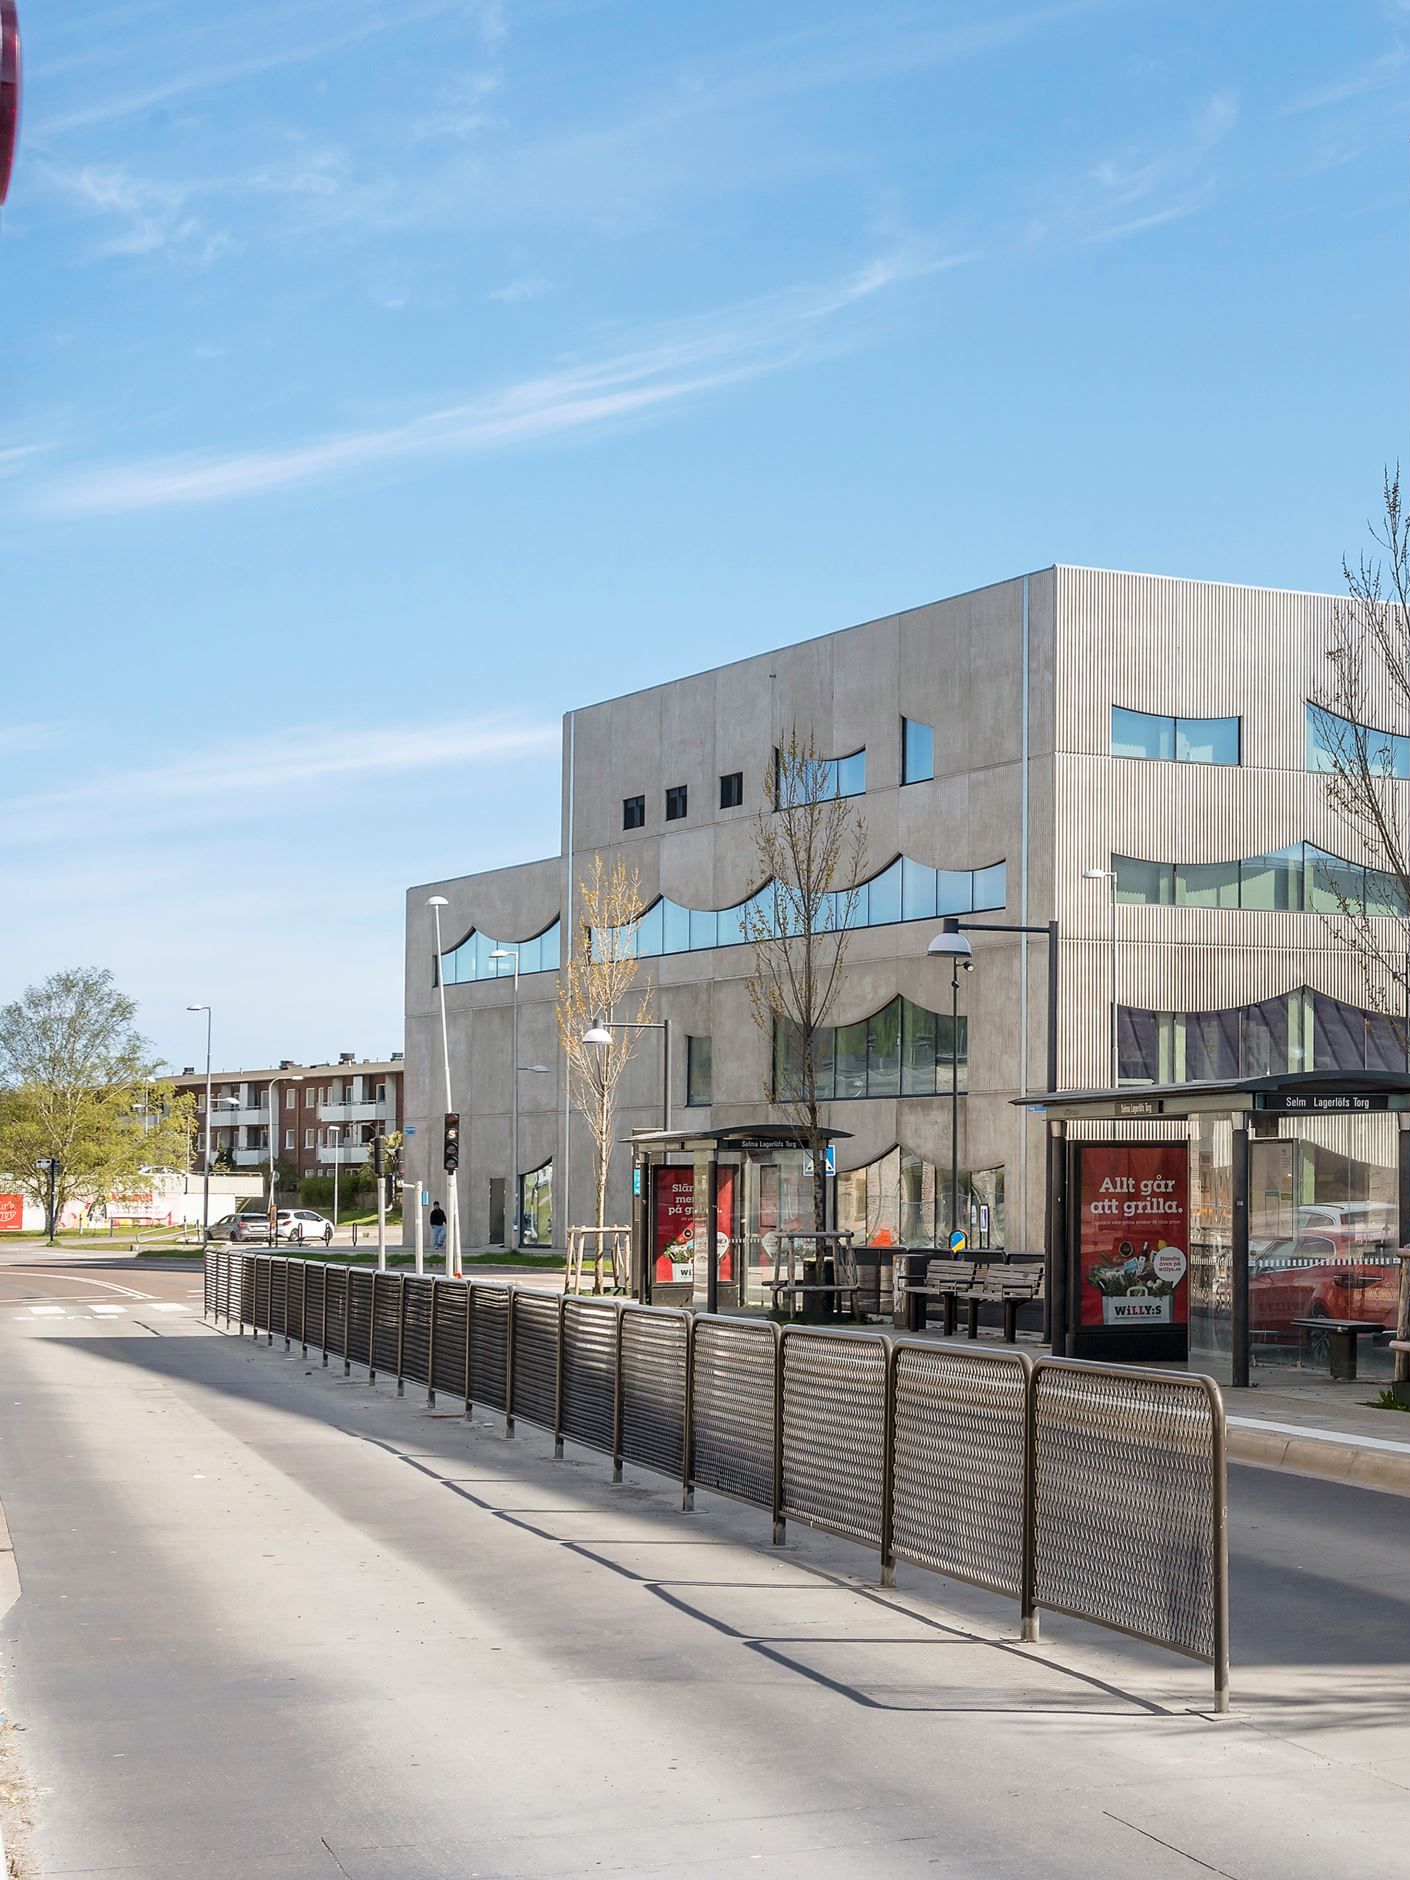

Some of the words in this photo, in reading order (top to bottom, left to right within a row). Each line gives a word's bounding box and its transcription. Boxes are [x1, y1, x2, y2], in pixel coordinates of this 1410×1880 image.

[1313, 1097, 1350, 1109] Lagerlöfs
[1353, 1097, 1370, 1109] Torg
[1099, 1177, 1136, 1193] Allt
[1140, 1174, 1176, 1195] går
[668, 1204, 683, 1216] på
[1090, 1198, 1119, 1214] att
[1123, 1197, 1184, 1216] grilla.
